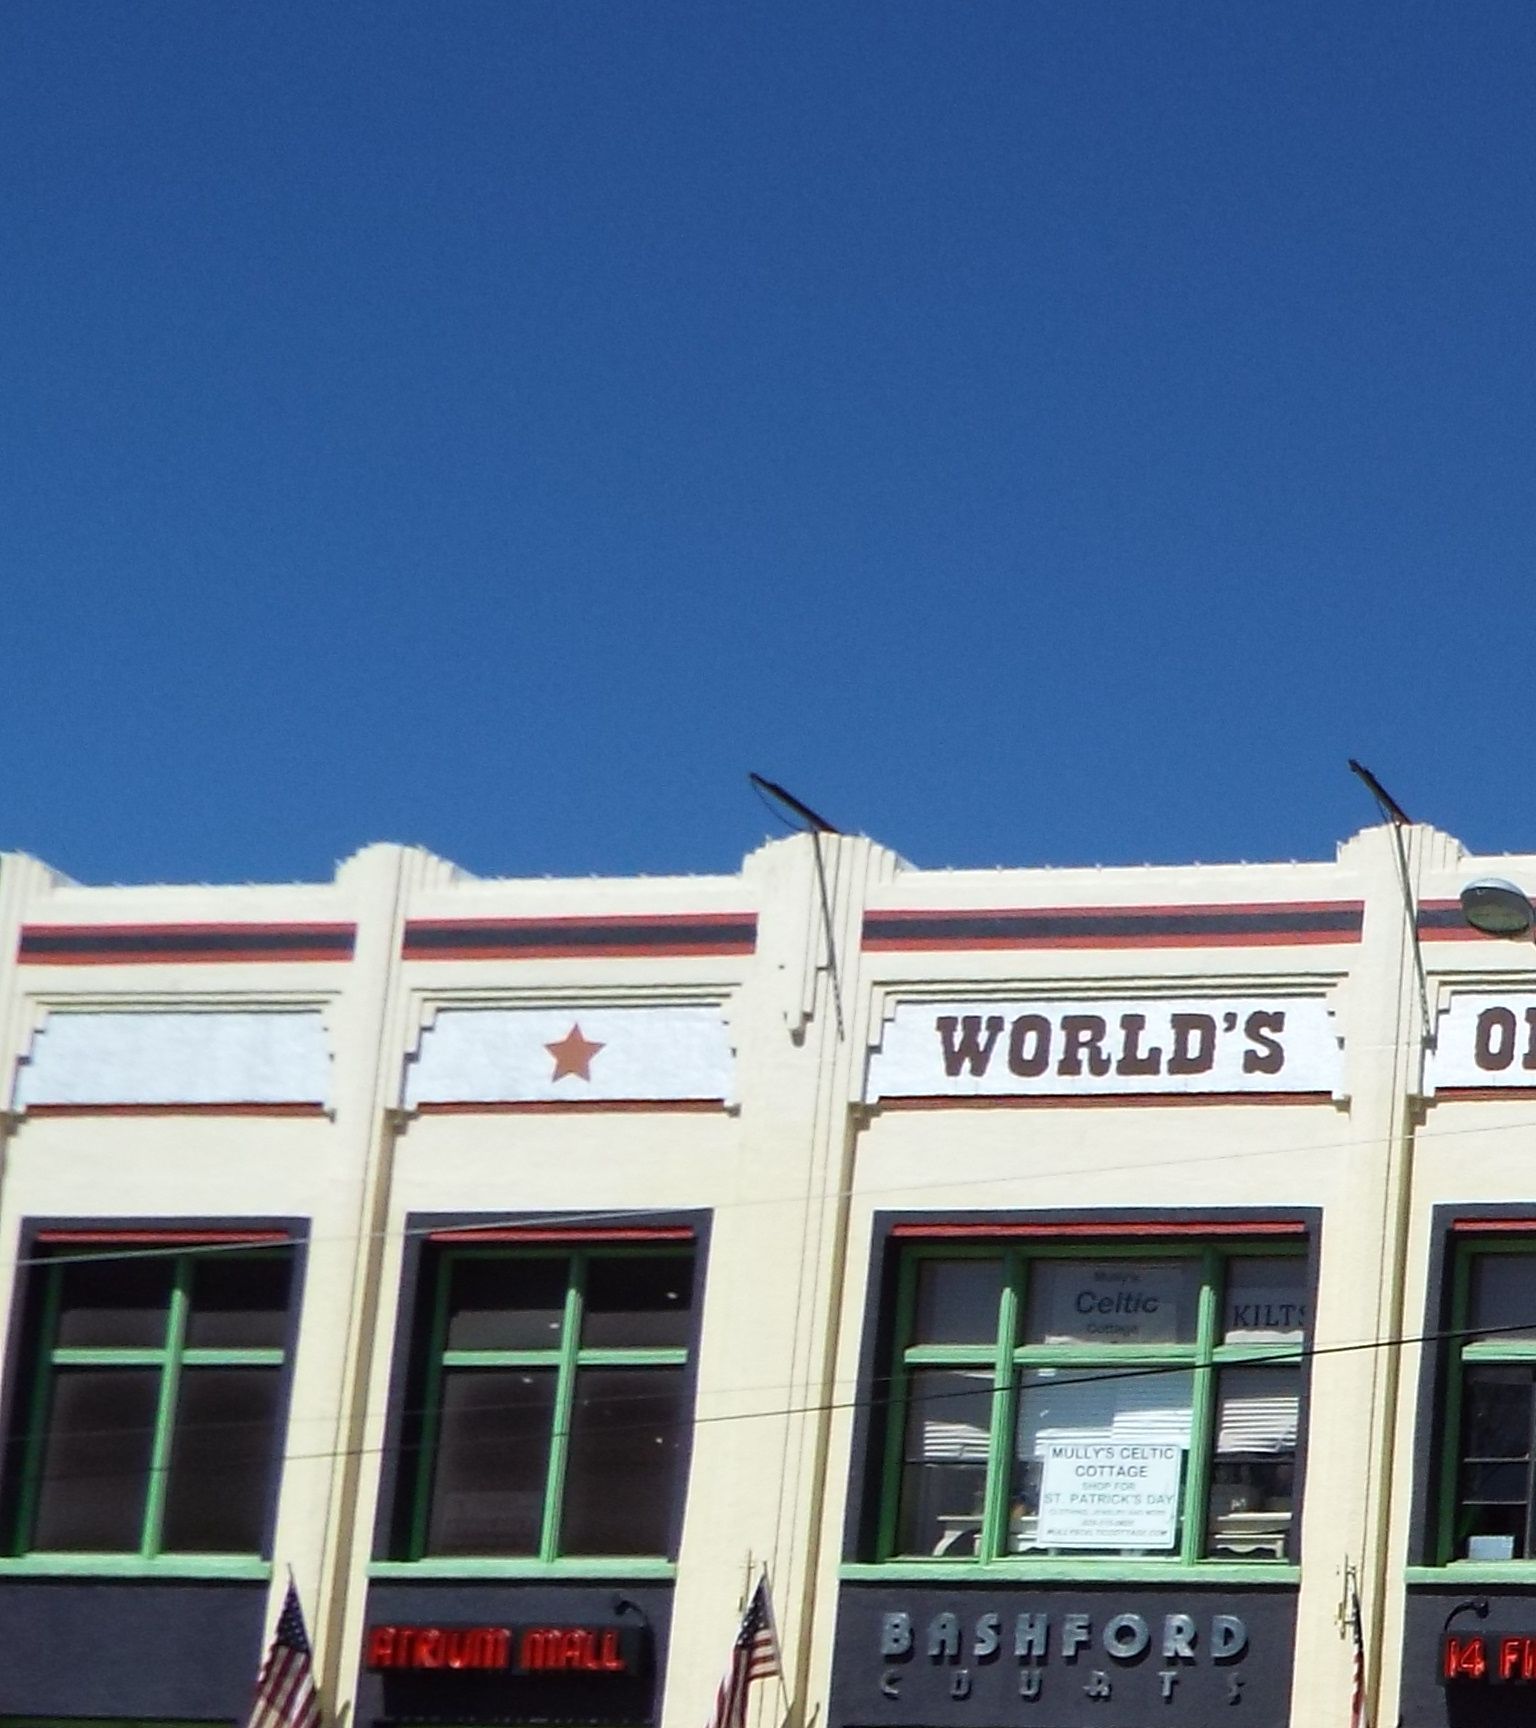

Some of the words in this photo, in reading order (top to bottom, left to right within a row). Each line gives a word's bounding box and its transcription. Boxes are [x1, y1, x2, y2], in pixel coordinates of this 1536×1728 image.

[935, 1011, 1286, 1078] WORLD'S
[1076, 1290, 1160, 1315] Celtic
[1050, 1447, 1115, 1460] MULLY'S
[1120, 1447, 1174, 1460] CELTIC
[1075, 1465, 1149, 1478] COTTAGE
[1070, 1494, 1142, 1505] PATRICK'S
[880, 1612, 1250, 1659] BASHFORD
[1444, 1637, 1486, 1680] 14
